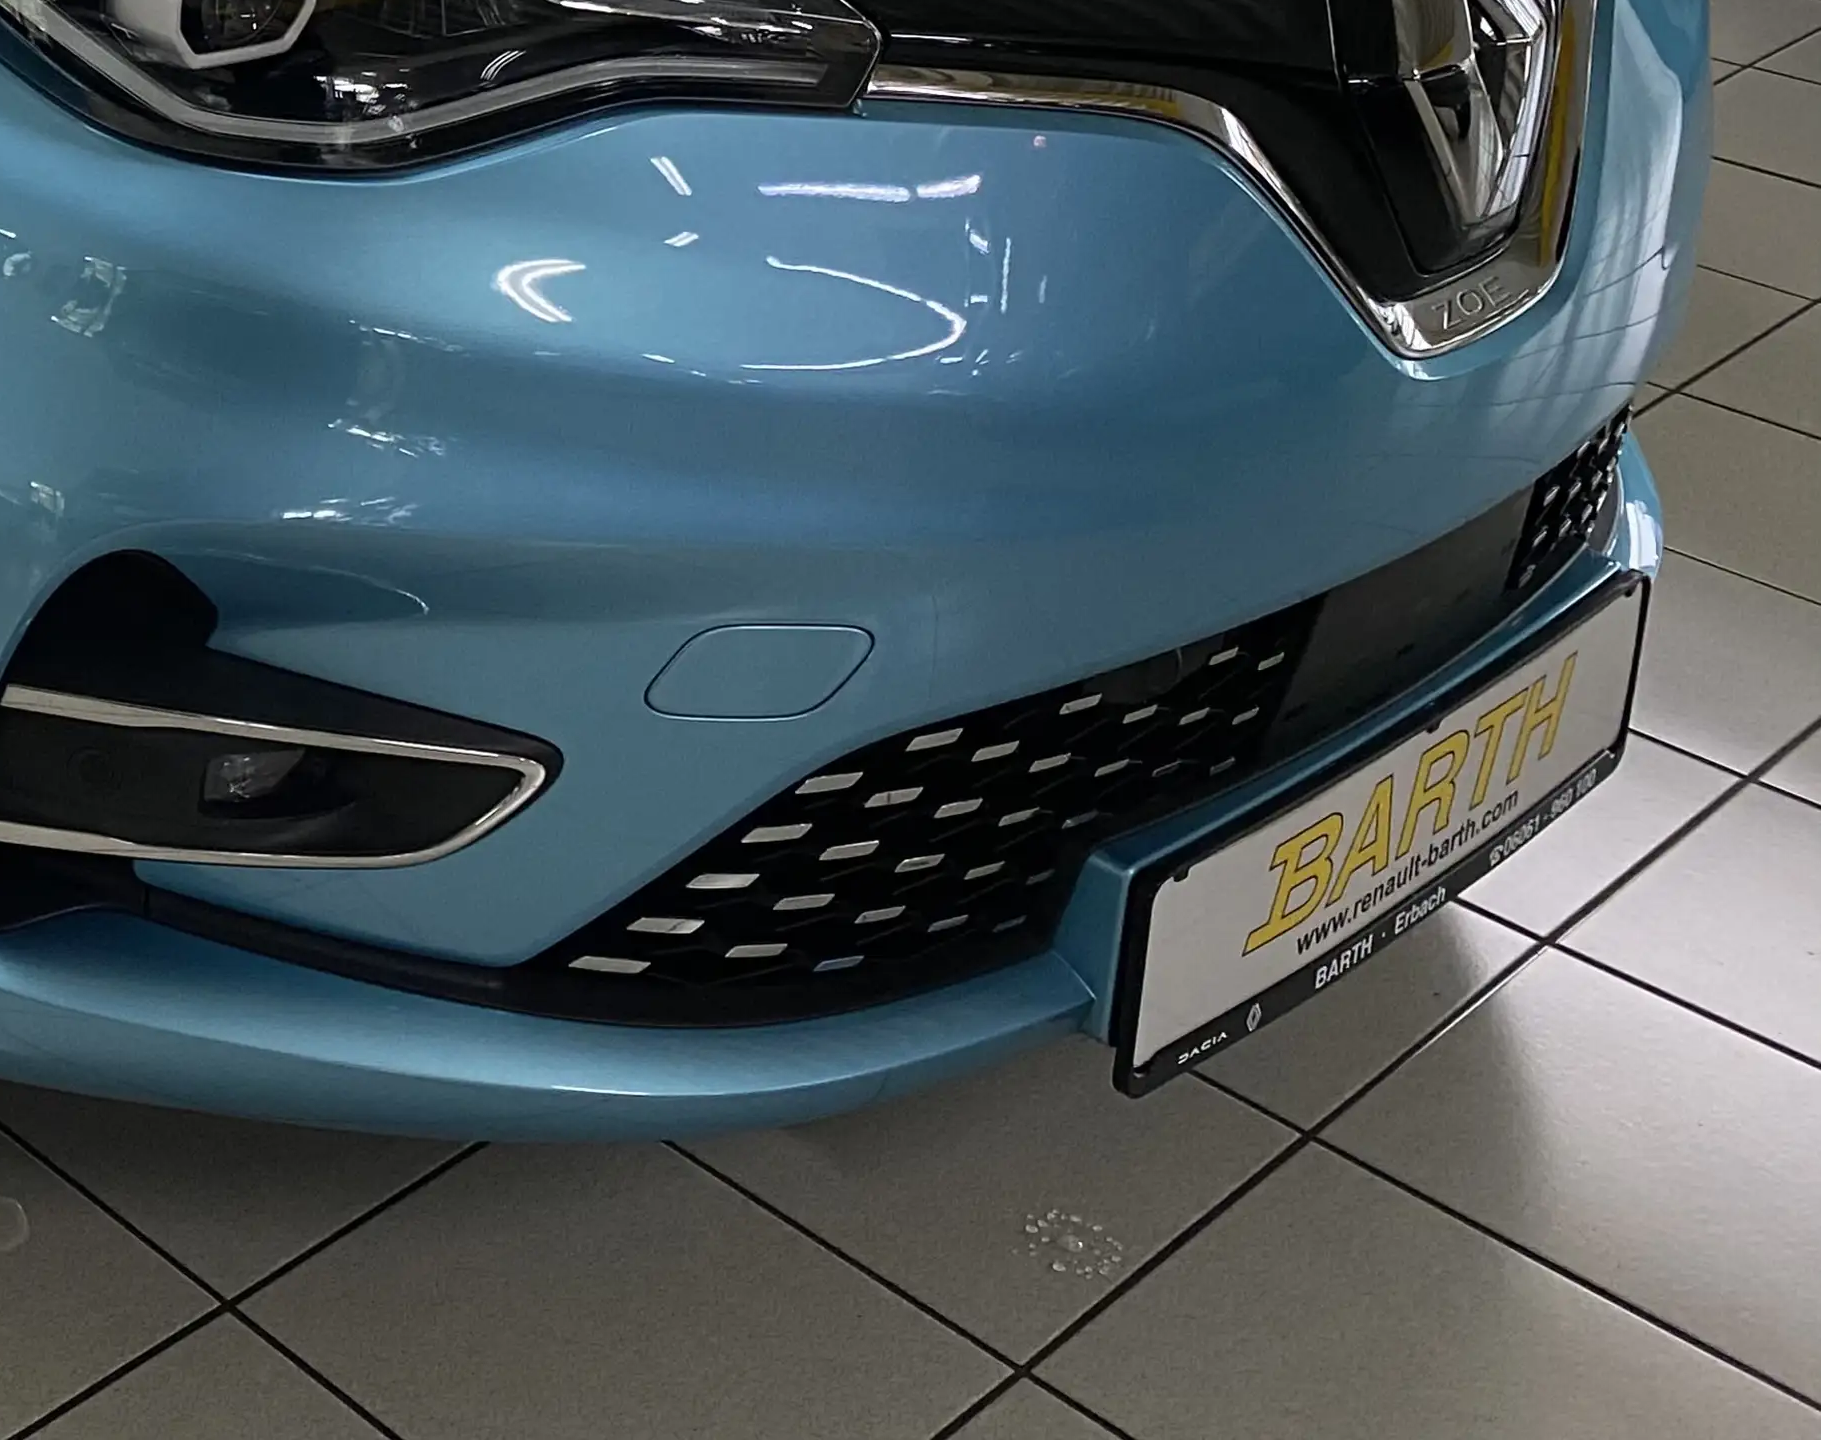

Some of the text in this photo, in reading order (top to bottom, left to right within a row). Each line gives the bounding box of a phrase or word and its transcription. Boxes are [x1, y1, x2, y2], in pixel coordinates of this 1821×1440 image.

[1432, 276, 1513, 330] ZOE
[1242, 650, 1578, 957] BARTH
[1296, 791, 1519, 955] www.renault-barth.com
[1178, 1032, 1228, 1065] DACIA
[1315, 934, 1374, 989] BARTH
[1394, 887, 1447, 935] Erbach
